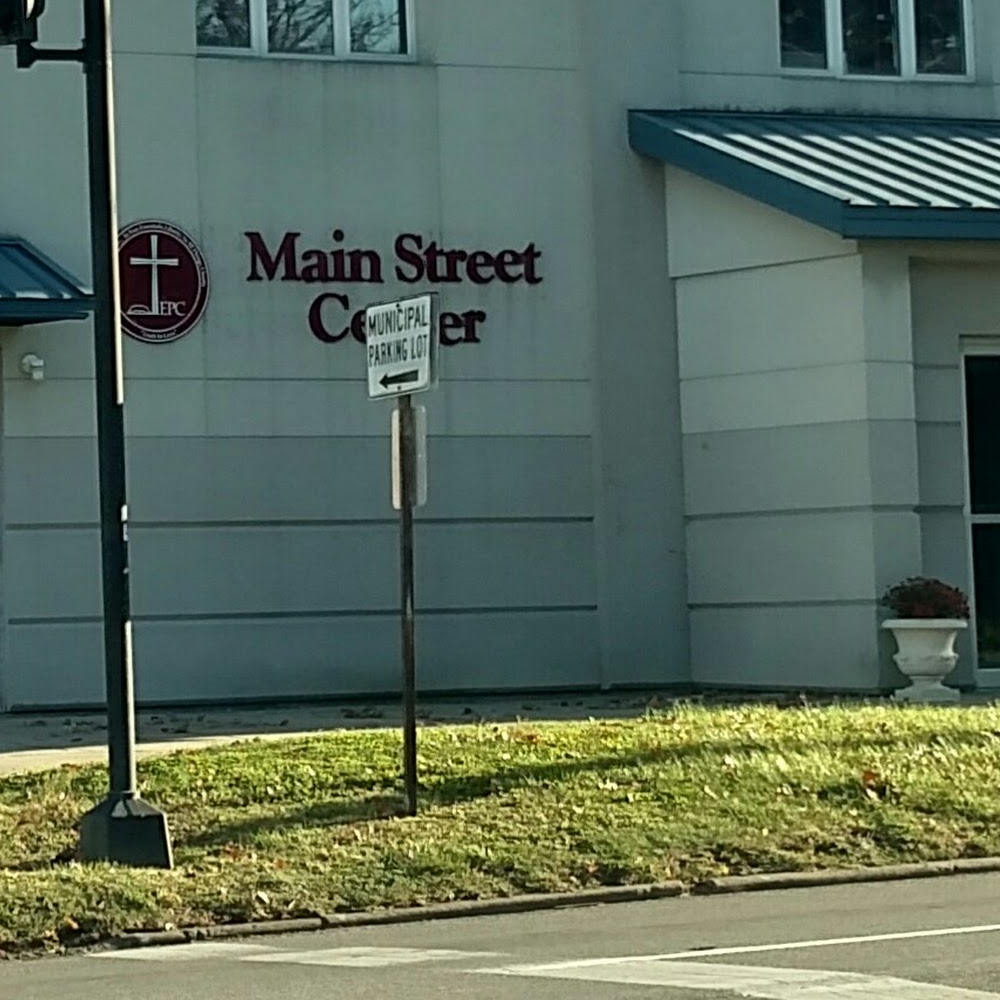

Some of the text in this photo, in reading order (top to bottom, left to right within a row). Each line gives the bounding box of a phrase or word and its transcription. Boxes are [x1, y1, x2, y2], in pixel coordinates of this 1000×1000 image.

[244, 229, 384, 283] Main
[394, 233, 542, 284] Street
[308, 292, 486, 346] Ceer
[368, 304, 428, 337] MUNICIPAL
[368, 334, 428, 368] PARKING LOT
